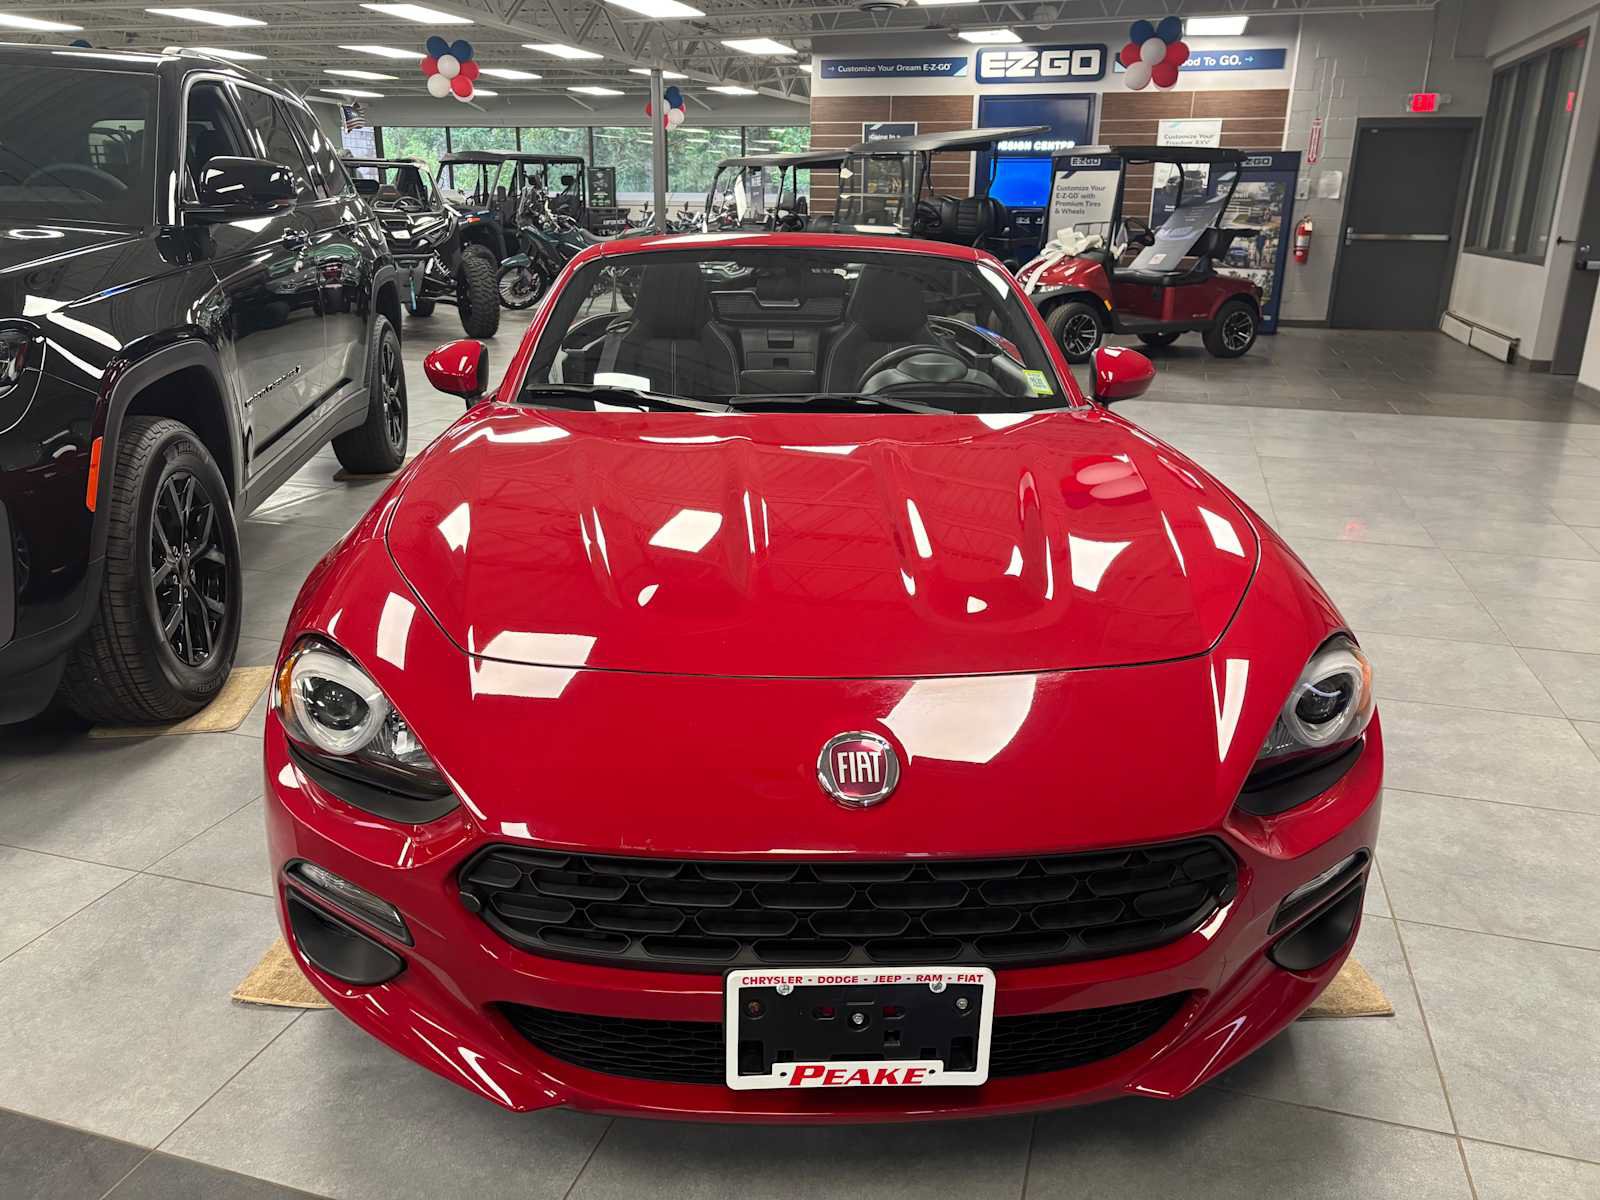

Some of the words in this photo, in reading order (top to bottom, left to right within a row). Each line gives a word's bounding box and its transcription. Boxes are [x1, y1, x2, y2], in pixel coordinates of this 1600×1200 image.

[1203, 56, 1217, 66] To
[1219, 55, 1242, 66] GO.
[837, 65, 876, 73] Customize
[877, 64, 895, 72] Your
[896, 63, 922, 72] Dream
[837, 751, 882, 784] FIAT
[741, 976, 803, 985] CHRYSLER
[817, 975, 859, 984] DODGE
[873, 975, 902, 983] JEEP
[915, 974, 943, 982] RAM
[957, 974, 984, 983] FIAT
